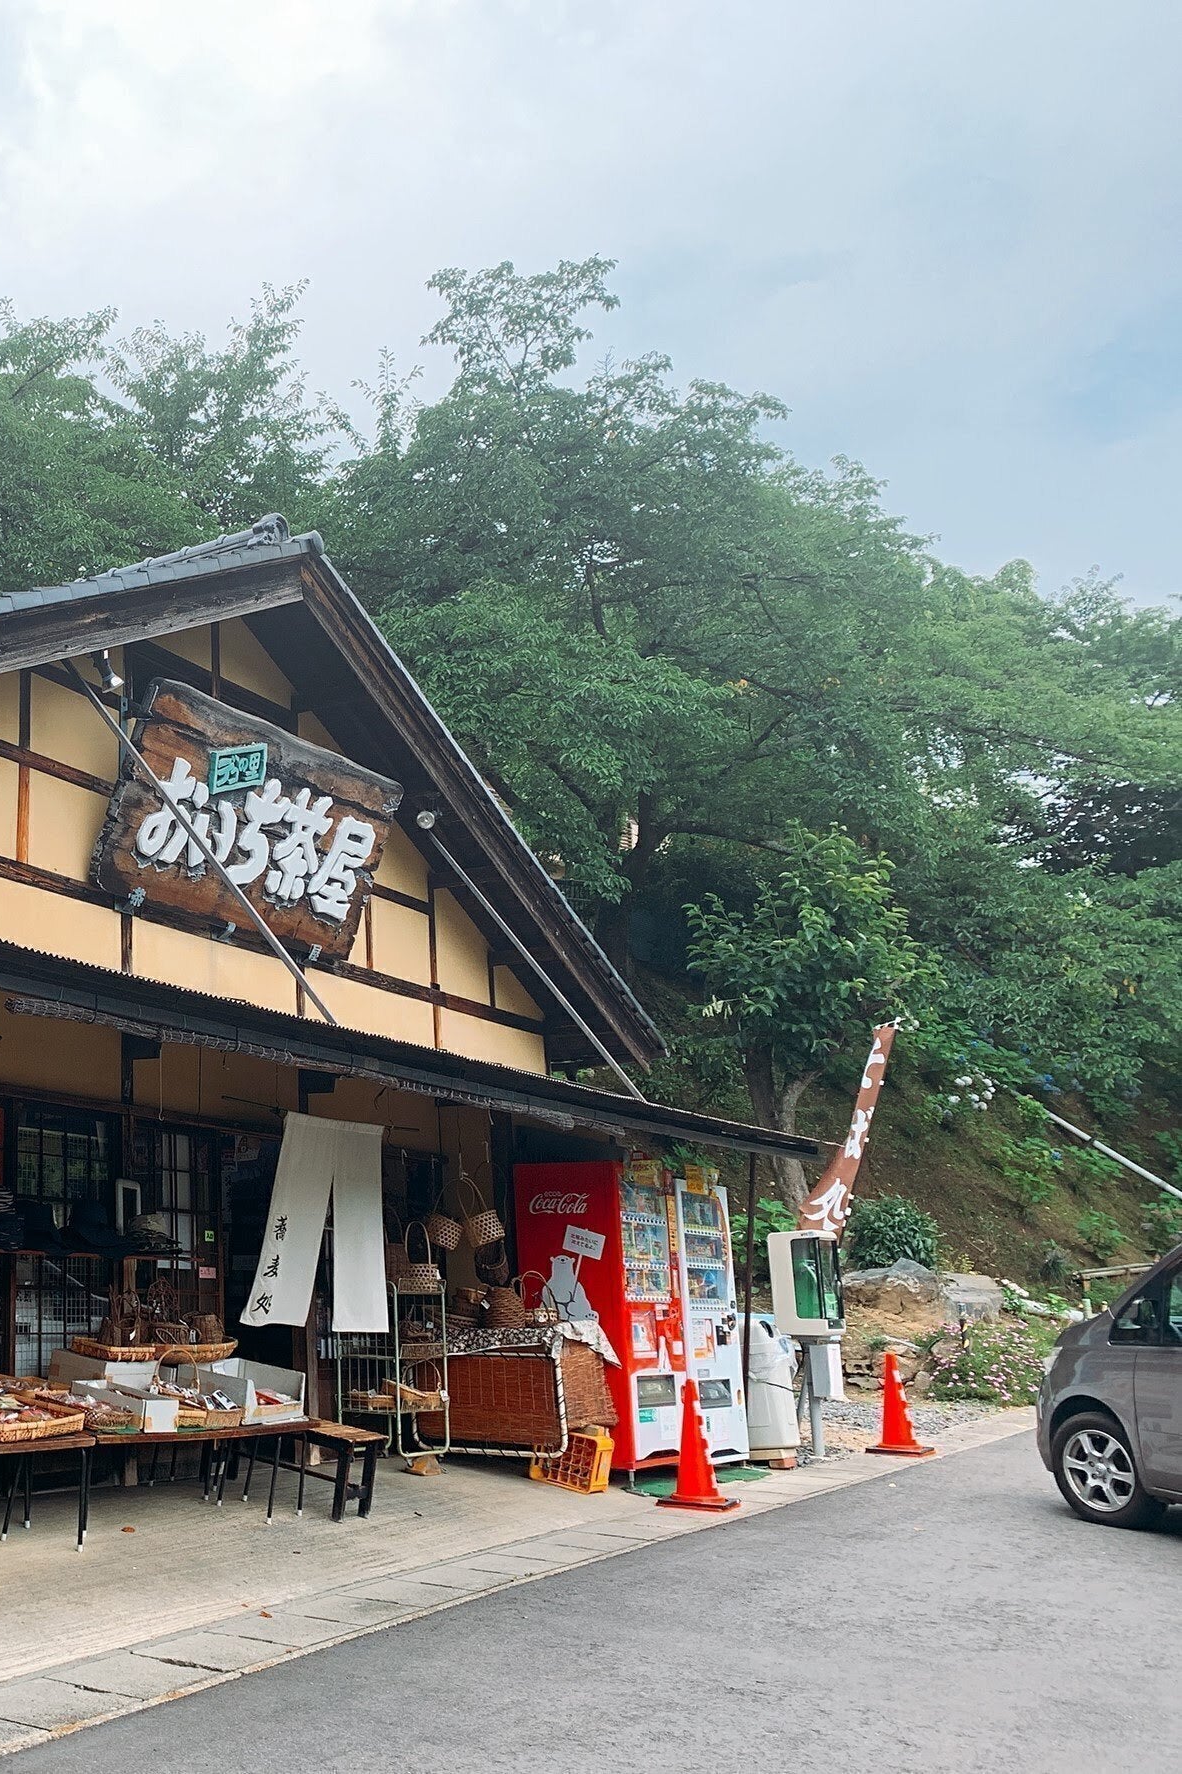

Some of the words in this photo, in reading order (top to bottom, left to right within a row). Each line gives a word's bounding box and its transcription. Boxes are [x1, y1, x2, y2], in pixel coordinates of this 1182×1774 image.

[137, 757, 375, 922] おいち茶屋
[529, 1192, 590, 1214] Coca-Cola
